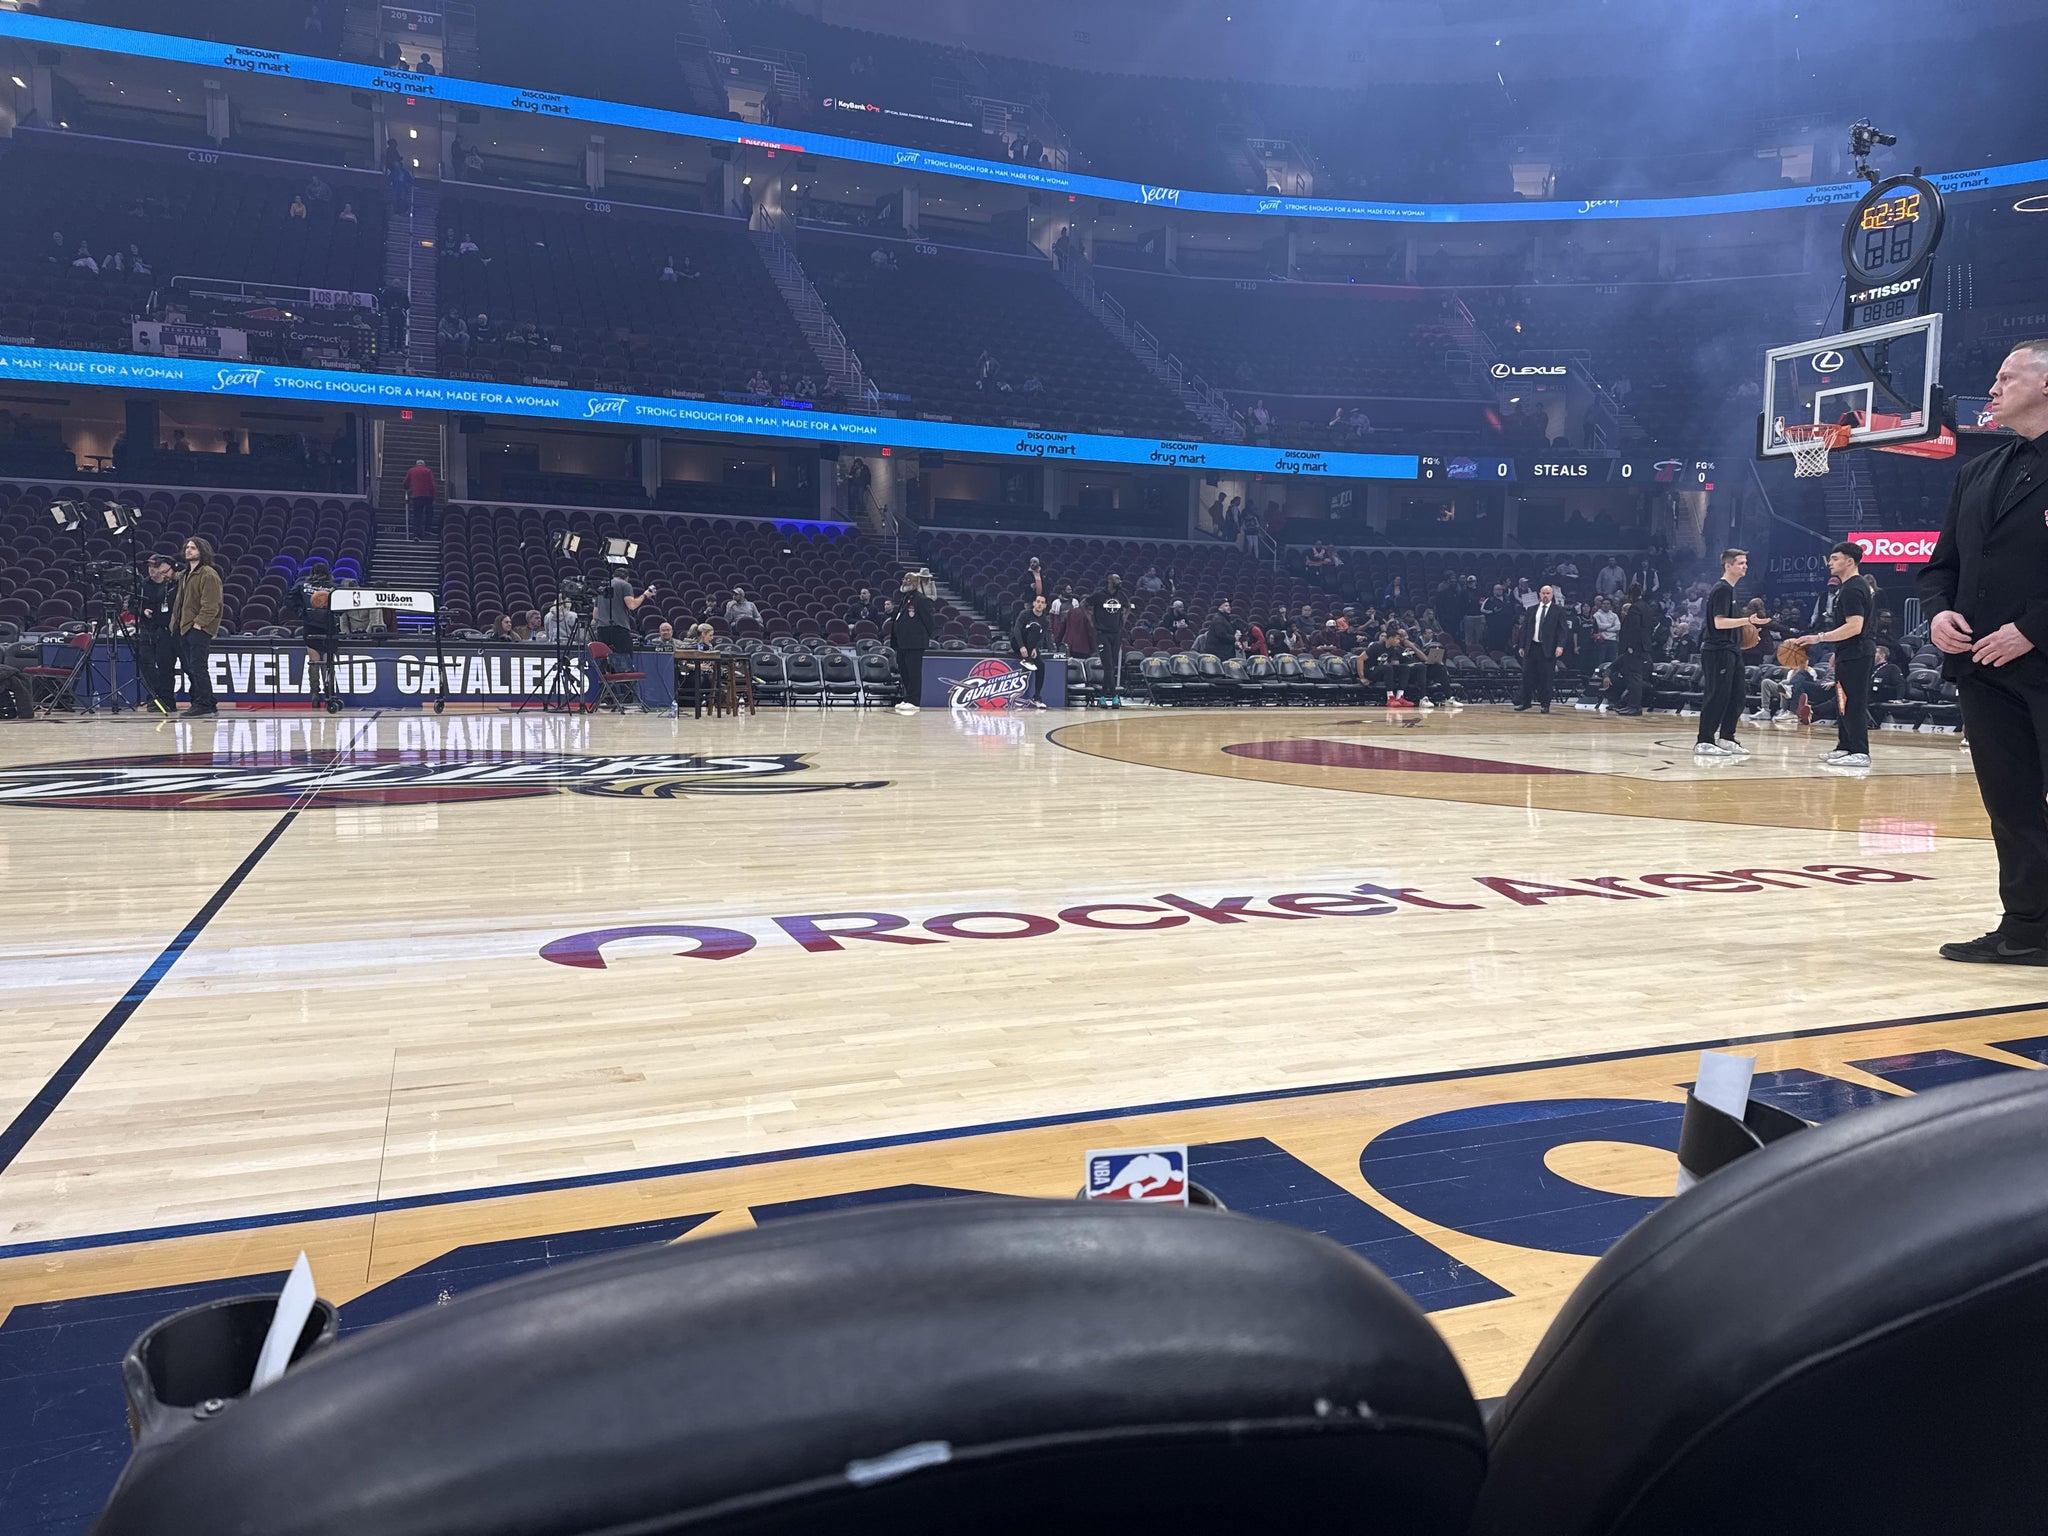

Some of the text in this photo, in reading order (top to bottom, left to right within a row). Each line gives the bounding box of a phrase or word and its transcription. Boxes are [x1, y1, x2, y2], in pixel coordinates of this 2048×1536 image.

[391, 11, 434, 24] 209 210
[236, 48, 280, 60] DISCOUNT
[224, 55, 290, 73] drug mart
[384, 70, 425, 82] DISCOUNT
[372, 77, 434, 94] drug mart
[521, 91, 560, 101] DISCOUNT
[511, 97, 569, 114] drug mart
[838, 100, 866, 110] KeyBank
[188, 152, 219, 164] C 107
[893, 151, 921, 165] Secret
[924, 158, 948, 168] STRONG
[950, 163, 975, 172] ENOUGH
[1011, 171, 1027, 180] MADE
[1028, 174, 1040, 182] FOR
[1046, 177, 1069, 186] WOMAN
[1942, 170, 1982, 181] DISCOUNT
[1961, 176, 1989, 188] mart
[1816, 184, 1853, 192] DISCOUNT
[1806, 191, 1860, 203] drug mart
[585, 202, 611, 213] C 108
[1256, 200, 1281, 213] Secret
[1285, 204, 1308, 212] STRONG
[1309, 205, 1333, 213] ENOUGH
[1367, 208, 1383, 216] MADE
[915, 245, 937, 255] C 109
[1869, 278, 1921, 299] TISSOT
[312, 290, 362, 305] LOS CAVS
[174, 334, 207, 347] WTAM
[50, 361, 85, 373] MADE
[90, 363, 116, 375] FOR
[119, 366, 128, 376] A
[131, 367, 183, 380] WOMAN
[1512, 366, 1567, 375] LEXUS
[212, 368, 559, 408] Secret STRONG ENOUGH FOR A MAN, MADE FOR A WOMAN
[583, 397, 629, 418] Secret
[635, 406, 677, 418] STRONG
[680, 409, 722, 422] ENOUGH
[725, 413, 744, 424] FOR
[746, 414, 753, 424] A
[781, 419, 808, 429] MADE
[810, 421, 829, 431] FOR
[831, 423, 838, 432] A
[840, 424, 877, 434] WOMAN
[1027, 431, 1068, 442] DISCOUNT
[1016, 440, 1076, 456] drug mart
[1161, 441, 1198, 451] DISCOUNT
[1150, 450, 1206, 465] drug mart
[1285, 451, 1321, 459] DISCOUNT
[1422, 457, 1440, 466] FG%
[1275, 458, 1328, 474] drug mart
[1497, 463, 1507, 477] 0
[1534, 464, 1588, 476] STEALS
[1621, 464, 1632, 478] 0
[1695, 461, 1715, 470] FG%
[1426, 470, 1433, 479] 0
[1698, 472, 1706, 483] 0
[1875, 538, 1937, 557] Rock
[375, 593, 413, 603] Wilson
[157, 653, 376, 694] EVELAND
[987, 671, 1019, 684] CLEVELAND
[950, 675, 1028, 708] CAVALIERS
[771, 864, 1937, 953] Rocket Arena
[1093, 1160, 1111, 1186] NBA
